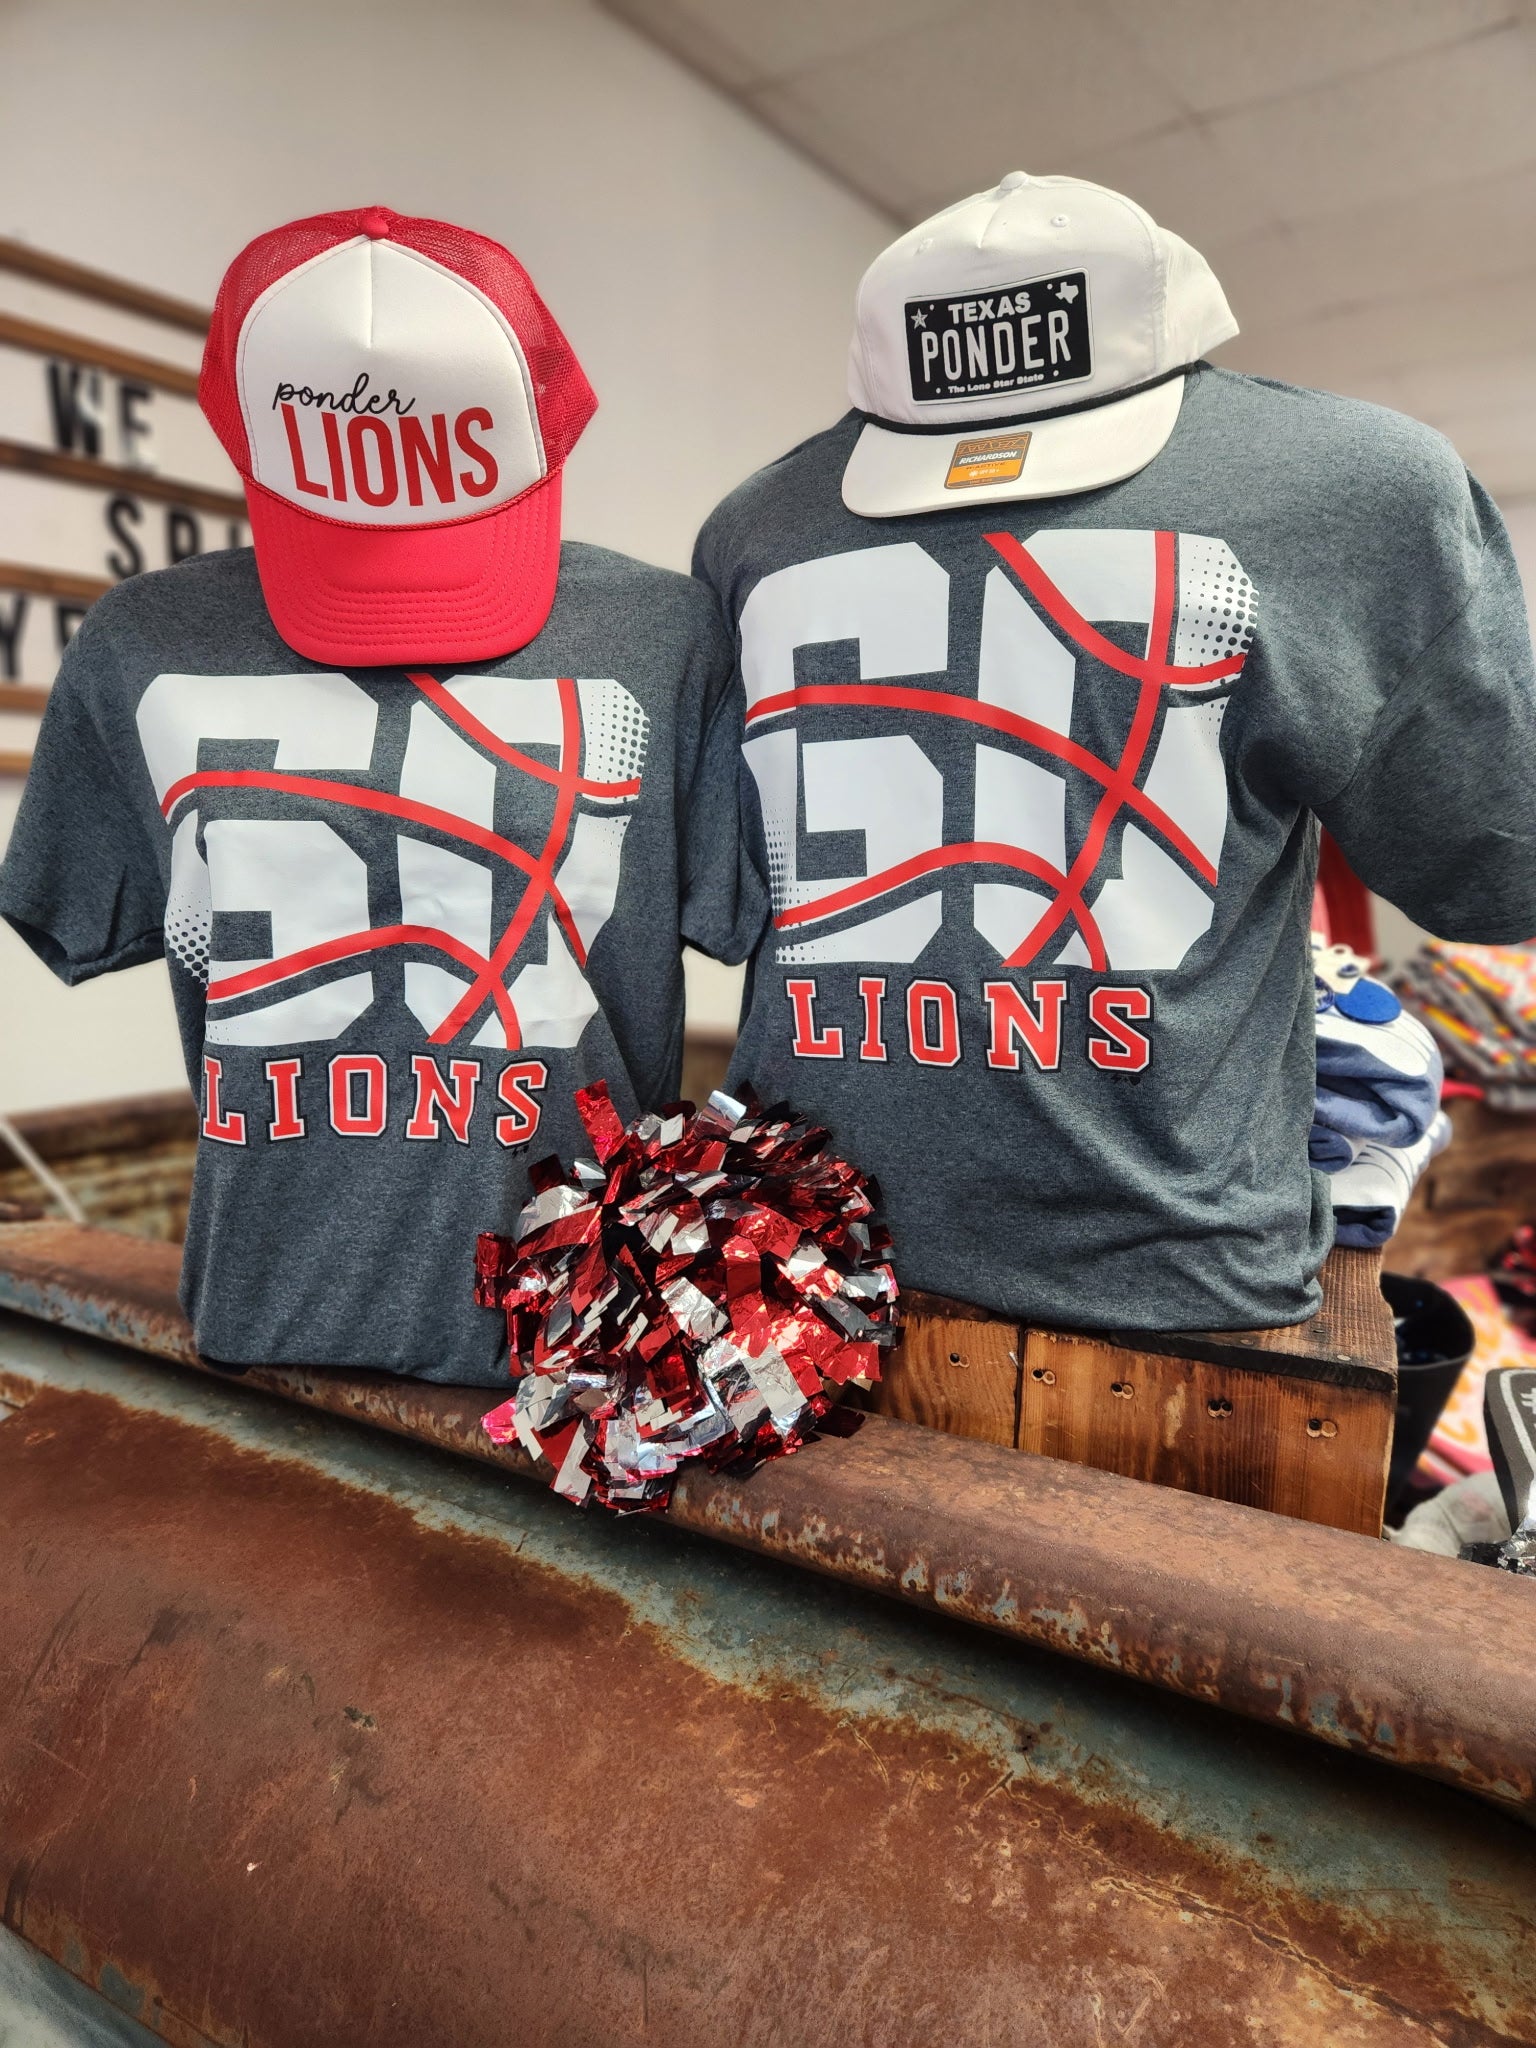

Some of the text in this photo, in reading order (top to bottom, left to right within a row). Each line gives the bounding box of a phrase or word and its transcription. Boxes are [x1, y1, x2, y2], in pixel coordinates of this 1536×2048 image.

[947, 291, 1032, 325] TEXAS
[920, 309, 1072, 383] PONDER
[45, 360, 158, 476] WE
[272, 372, 416, 415] ponder
[948, 385, 966, 394] The
[280, 402, 499, 507] LIONS
[959, 451, 1017, 464] RICHARDSON
[784, 975, 1154, 1073] LIONS
[202, 1050, 551, 1149] LIONS
